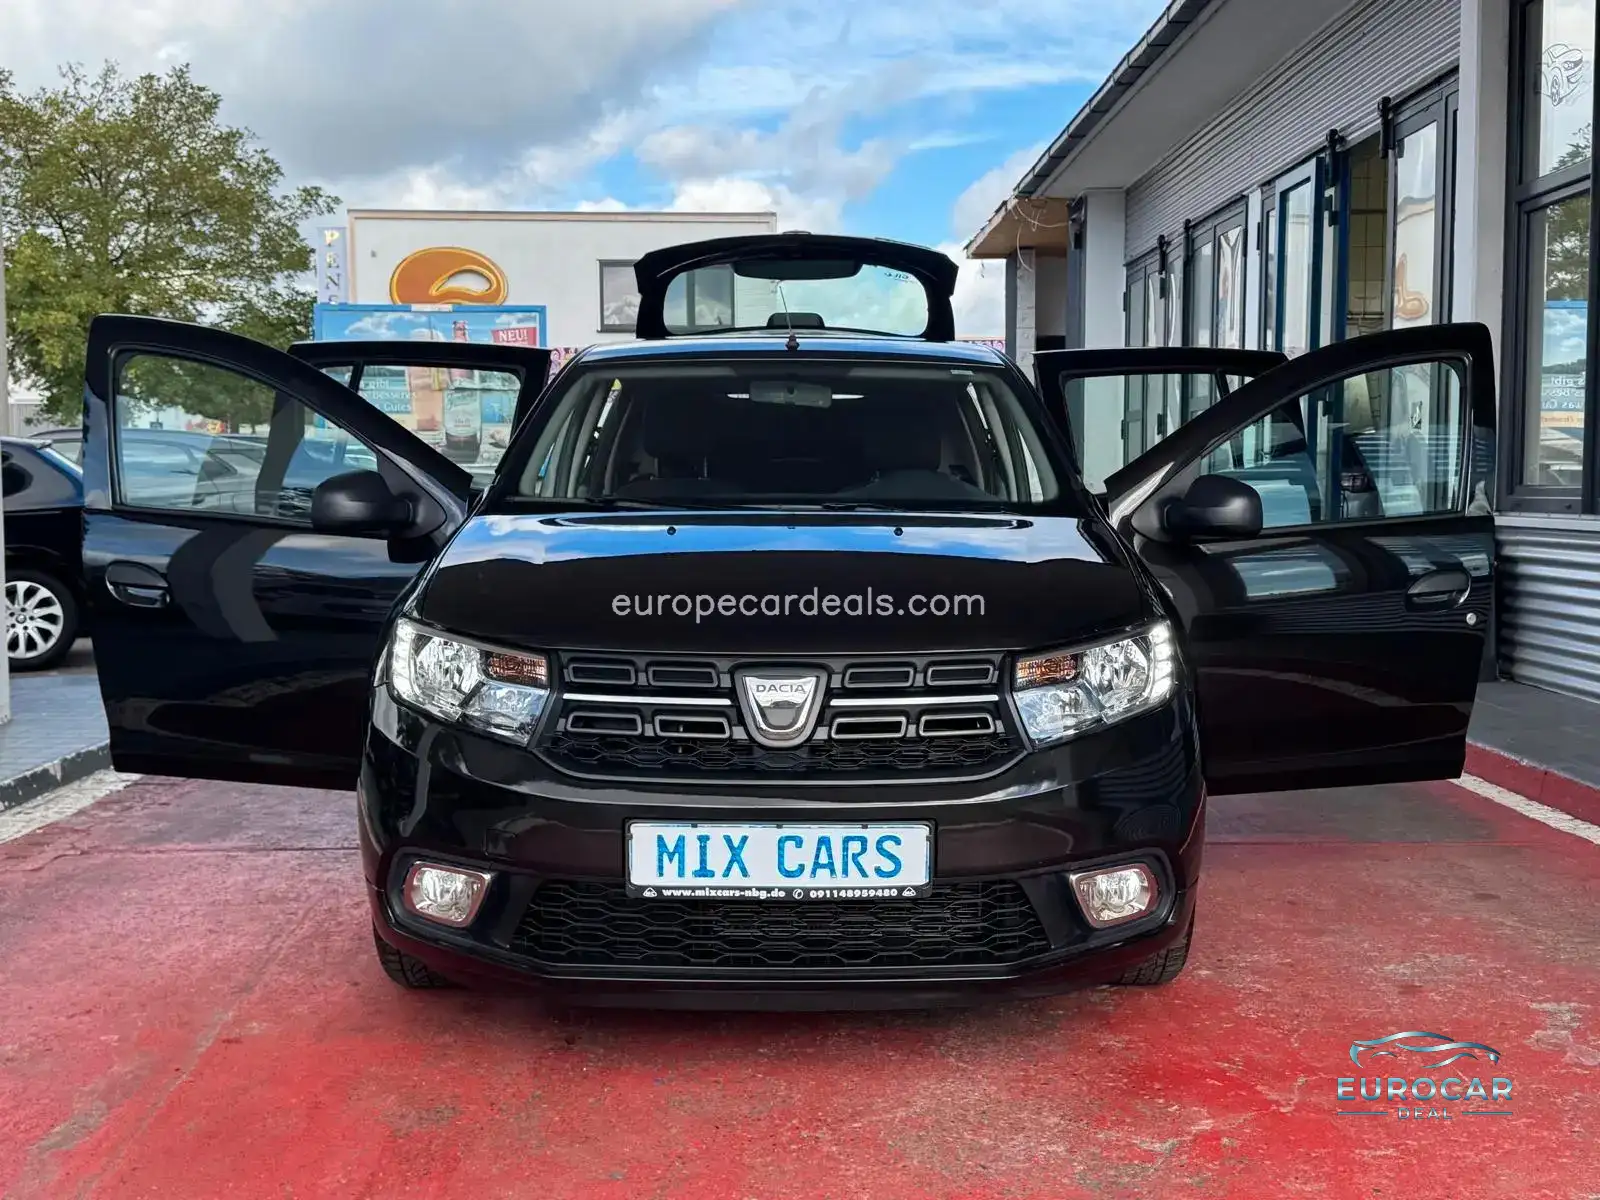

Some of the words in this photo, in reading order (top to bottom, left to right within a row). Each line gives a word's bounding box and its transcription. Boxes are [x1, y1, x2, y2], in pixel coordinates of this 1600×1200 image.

[499, 328, 528, 342] NEU!
[755, 684, 806, 693] DACIA
[656, 834, 750, 878] MIX
[777, 834, 902, 879] CARS
[661, 887, 786, 900] www.mixcars-nbg.de
[809, 888, 898, 898] 091148959480
